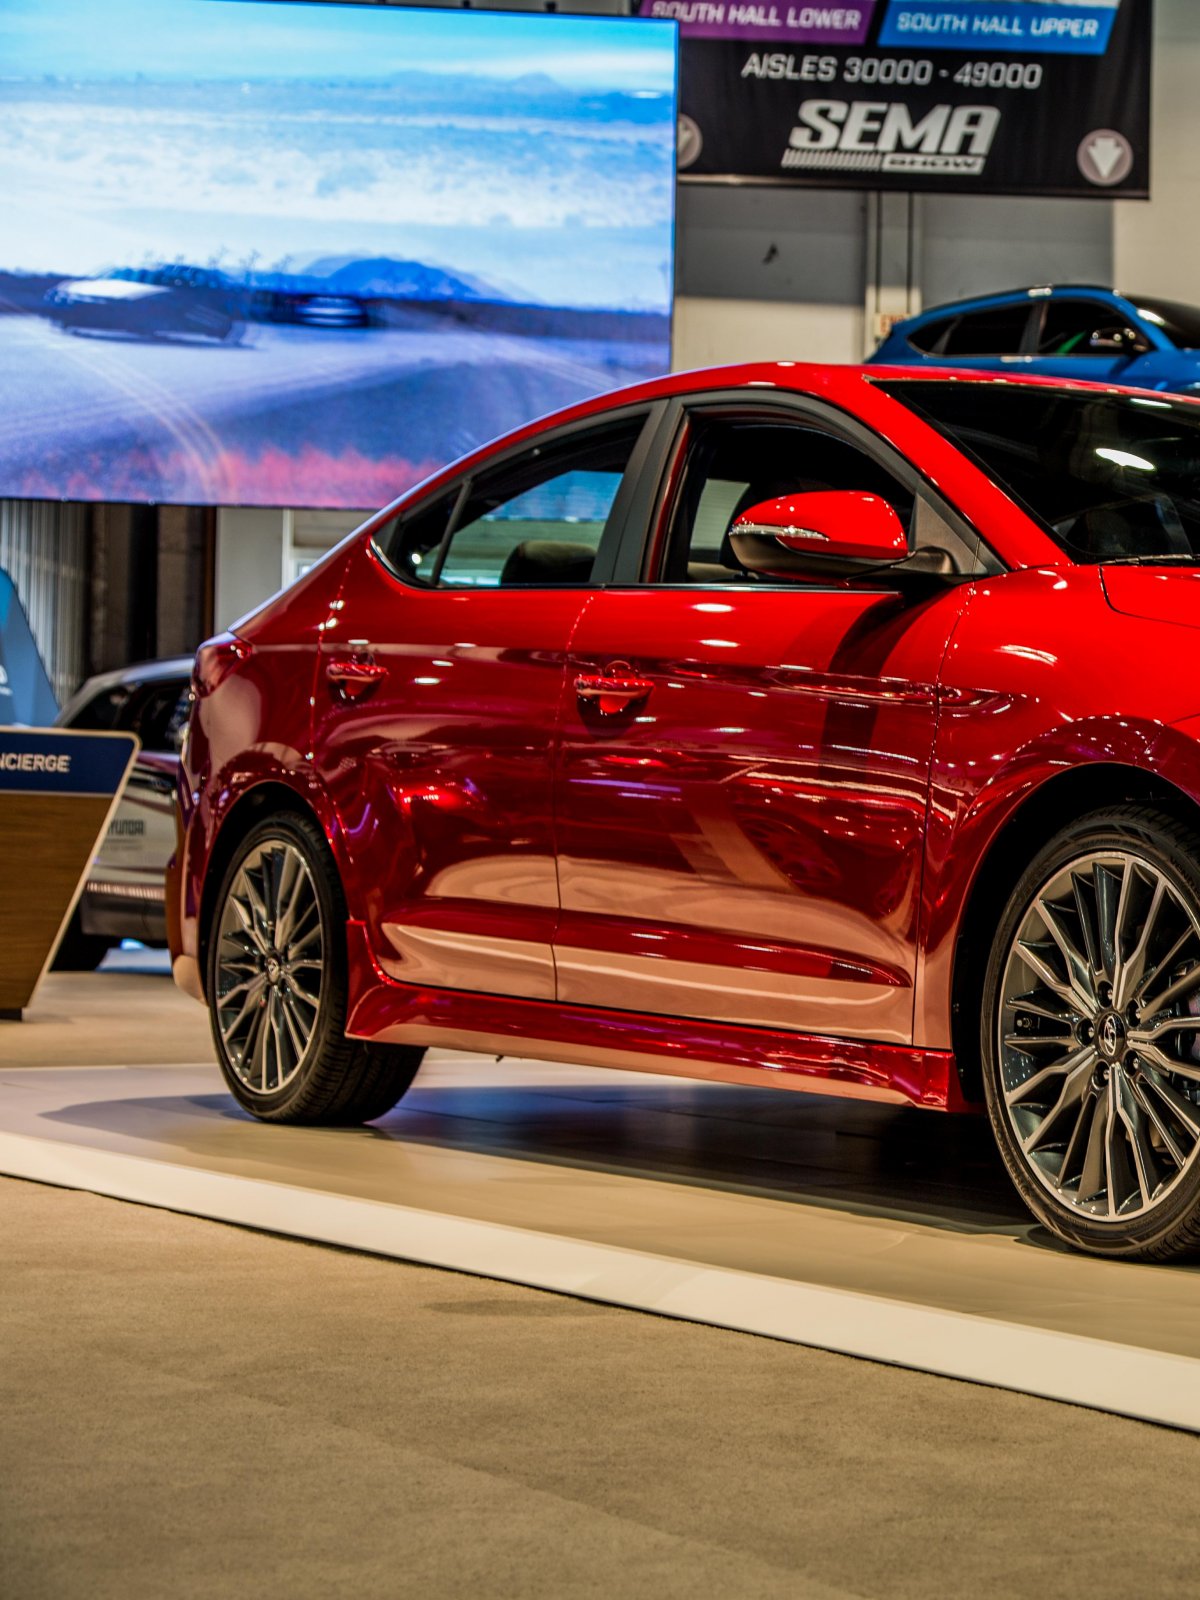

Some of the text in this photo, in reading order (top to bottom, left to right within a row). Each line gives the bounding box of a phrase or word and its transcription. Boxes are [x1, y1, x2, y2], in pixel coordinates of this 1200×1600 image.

[651, 1, 862, 30] SOUTH HALL LOWER
[897, 12, 1099, 39] SOUTH HALL UPPER
[741, 53, 838, 82] AISLES
[843, 57, 933, 86] 30000
[953, 61, 1042, 90] 49000
[788, 99, 1001, 156] SEMA
